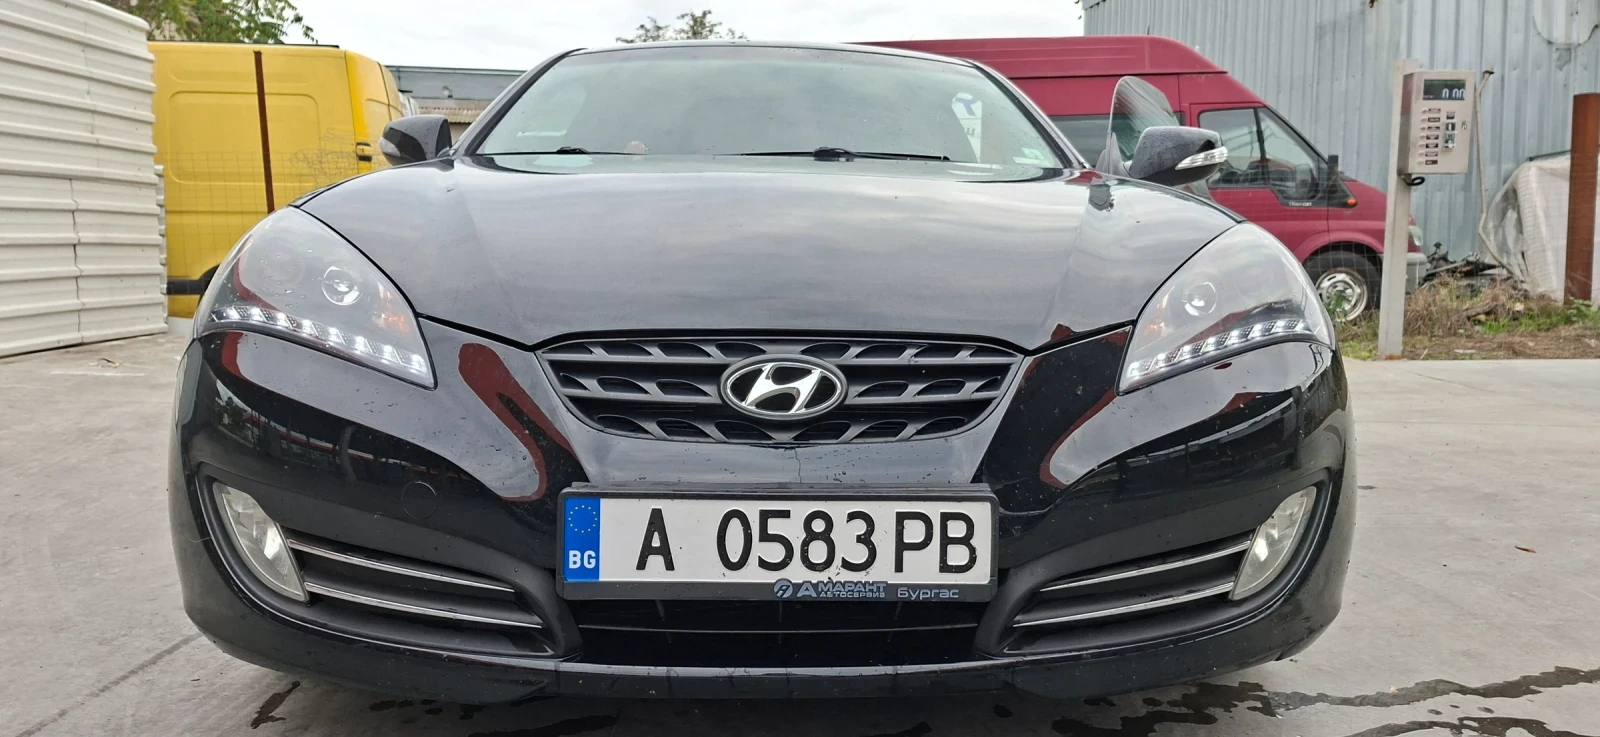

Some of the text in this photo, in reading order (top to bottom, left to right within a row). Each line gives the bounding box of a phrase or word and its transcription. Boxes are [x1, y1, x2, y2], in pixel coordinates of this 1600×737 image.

[636, 508, 978, 574] A 0583 PB
[568, 550, 596, 569] BG
[897, 587, 959, 600] Бургас
